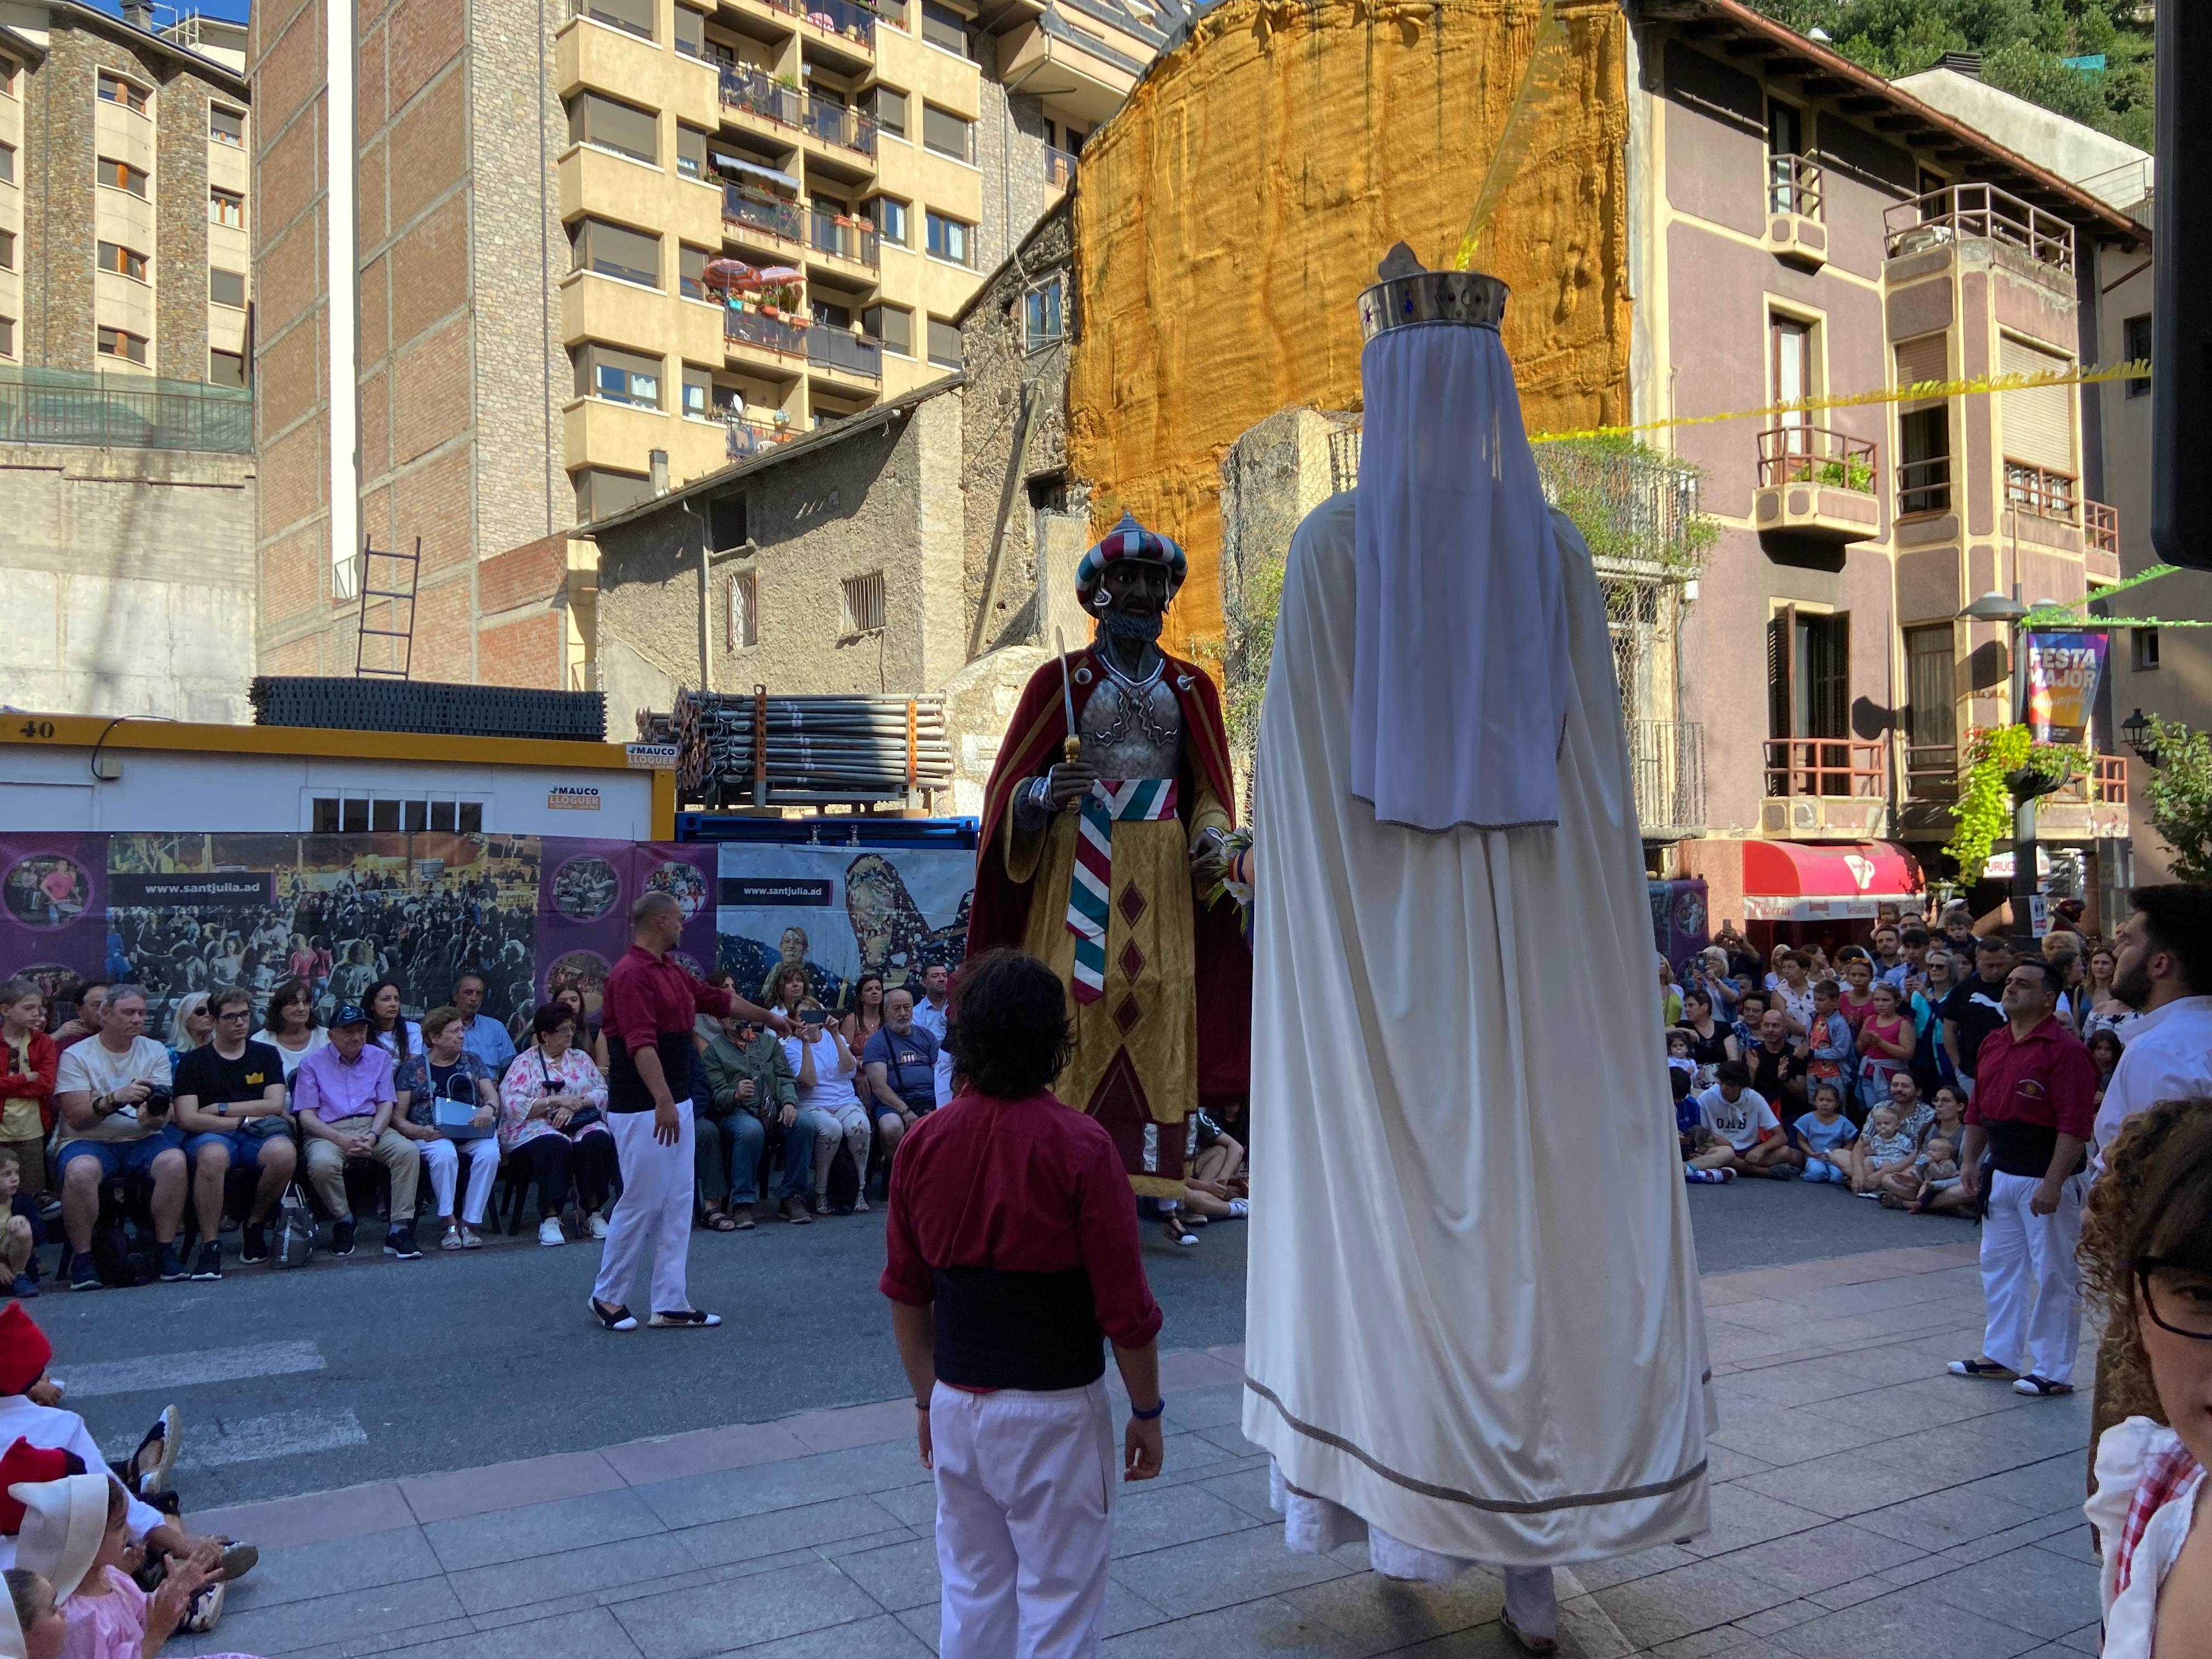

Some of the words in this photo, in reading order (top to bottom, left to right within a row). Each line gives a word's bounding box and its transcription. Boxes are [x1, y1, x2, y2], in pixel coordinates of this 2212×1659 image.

[2029, 647, 2096, 669] FESTA
[2030, 668, 2096, 688] MAJOR
[19, 720, 54, 738] 40
[636, 747, 675, 755] MAUCO
[628, 755, 675, 764] LLOGUER
[558, 787, 599, 795] MAUCO
[550, 796, 598, 805] LLOGUER
[145, 882, 260, 894] www.santjulia.ad
[743, 887, 822, 896] www.santjulia.ad
[1753, 900, 1791, 916] Pizzeria
